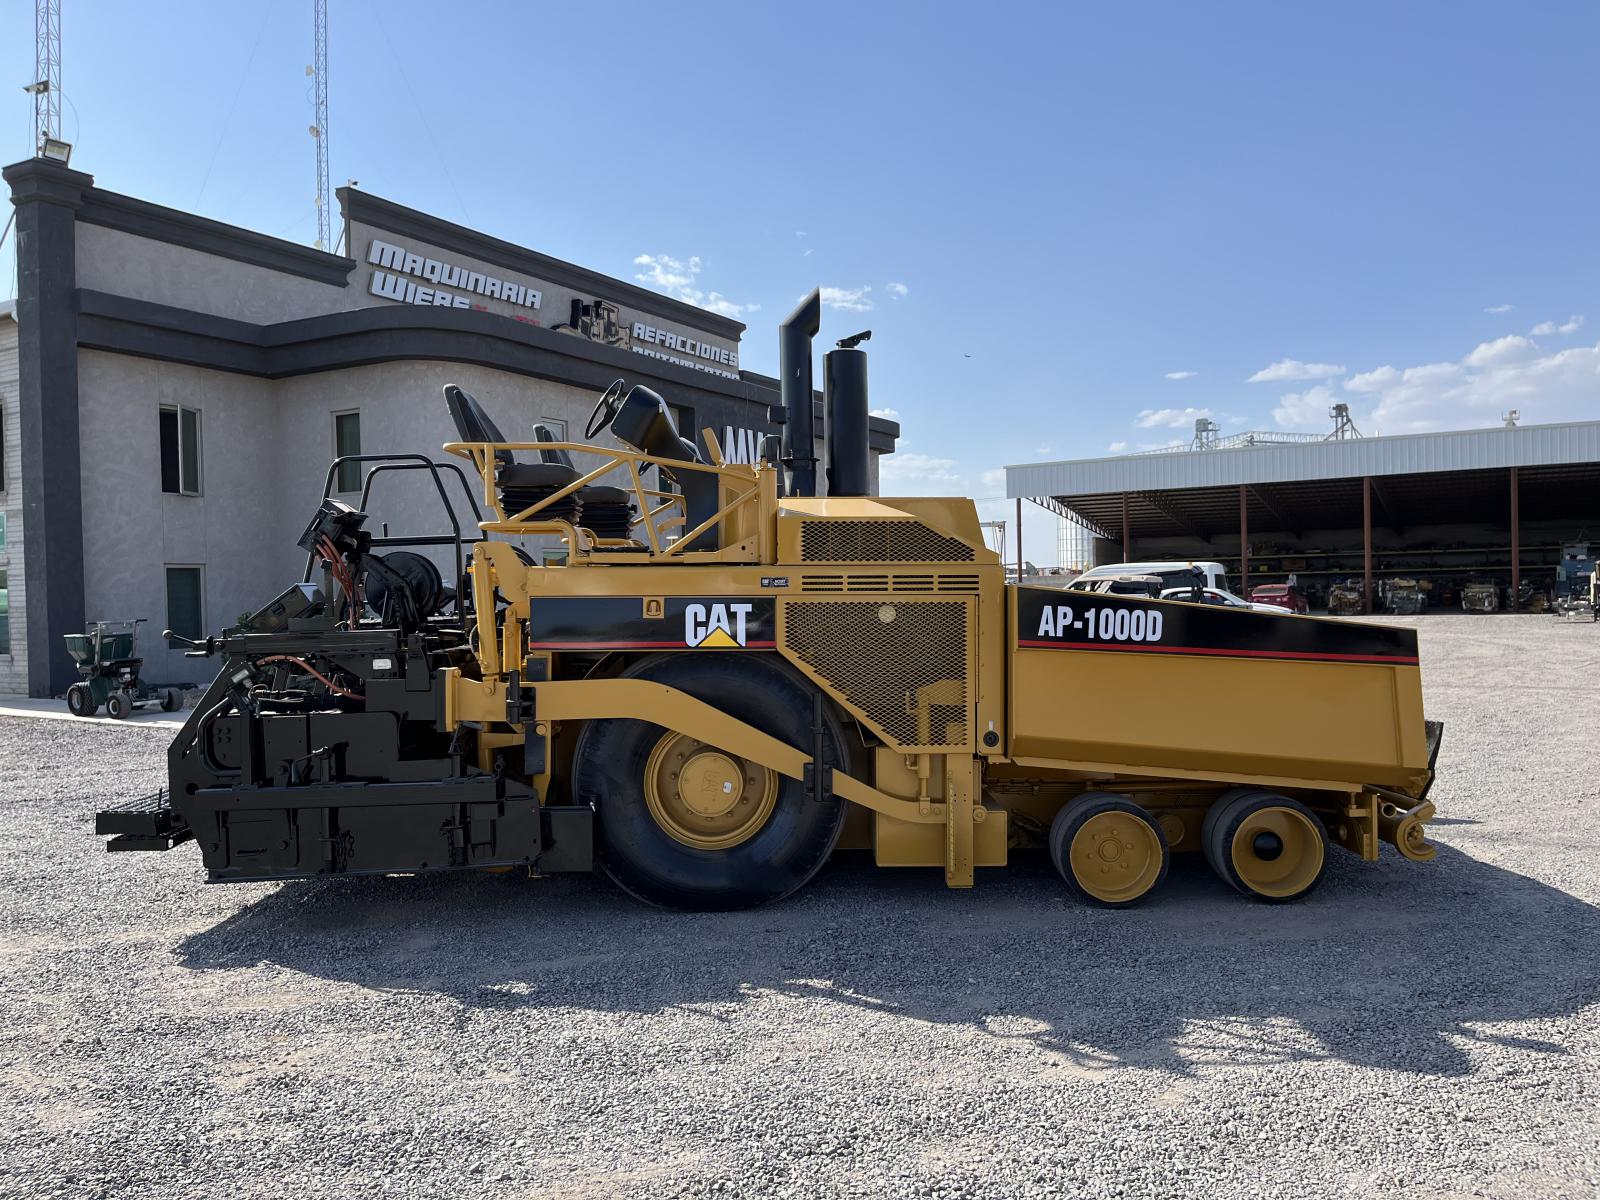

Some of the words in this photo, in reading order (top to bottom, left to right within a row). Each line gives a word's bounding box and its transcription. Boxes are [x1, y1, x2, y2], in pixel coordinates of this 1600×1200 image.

[369, 240, 542, 310] MAQUINARIA
[633, 322, 738, 367] REFACCIONES
[685, 604, 752, 647] CAT
[1038, 605, 1163, 642] AP-1000D
